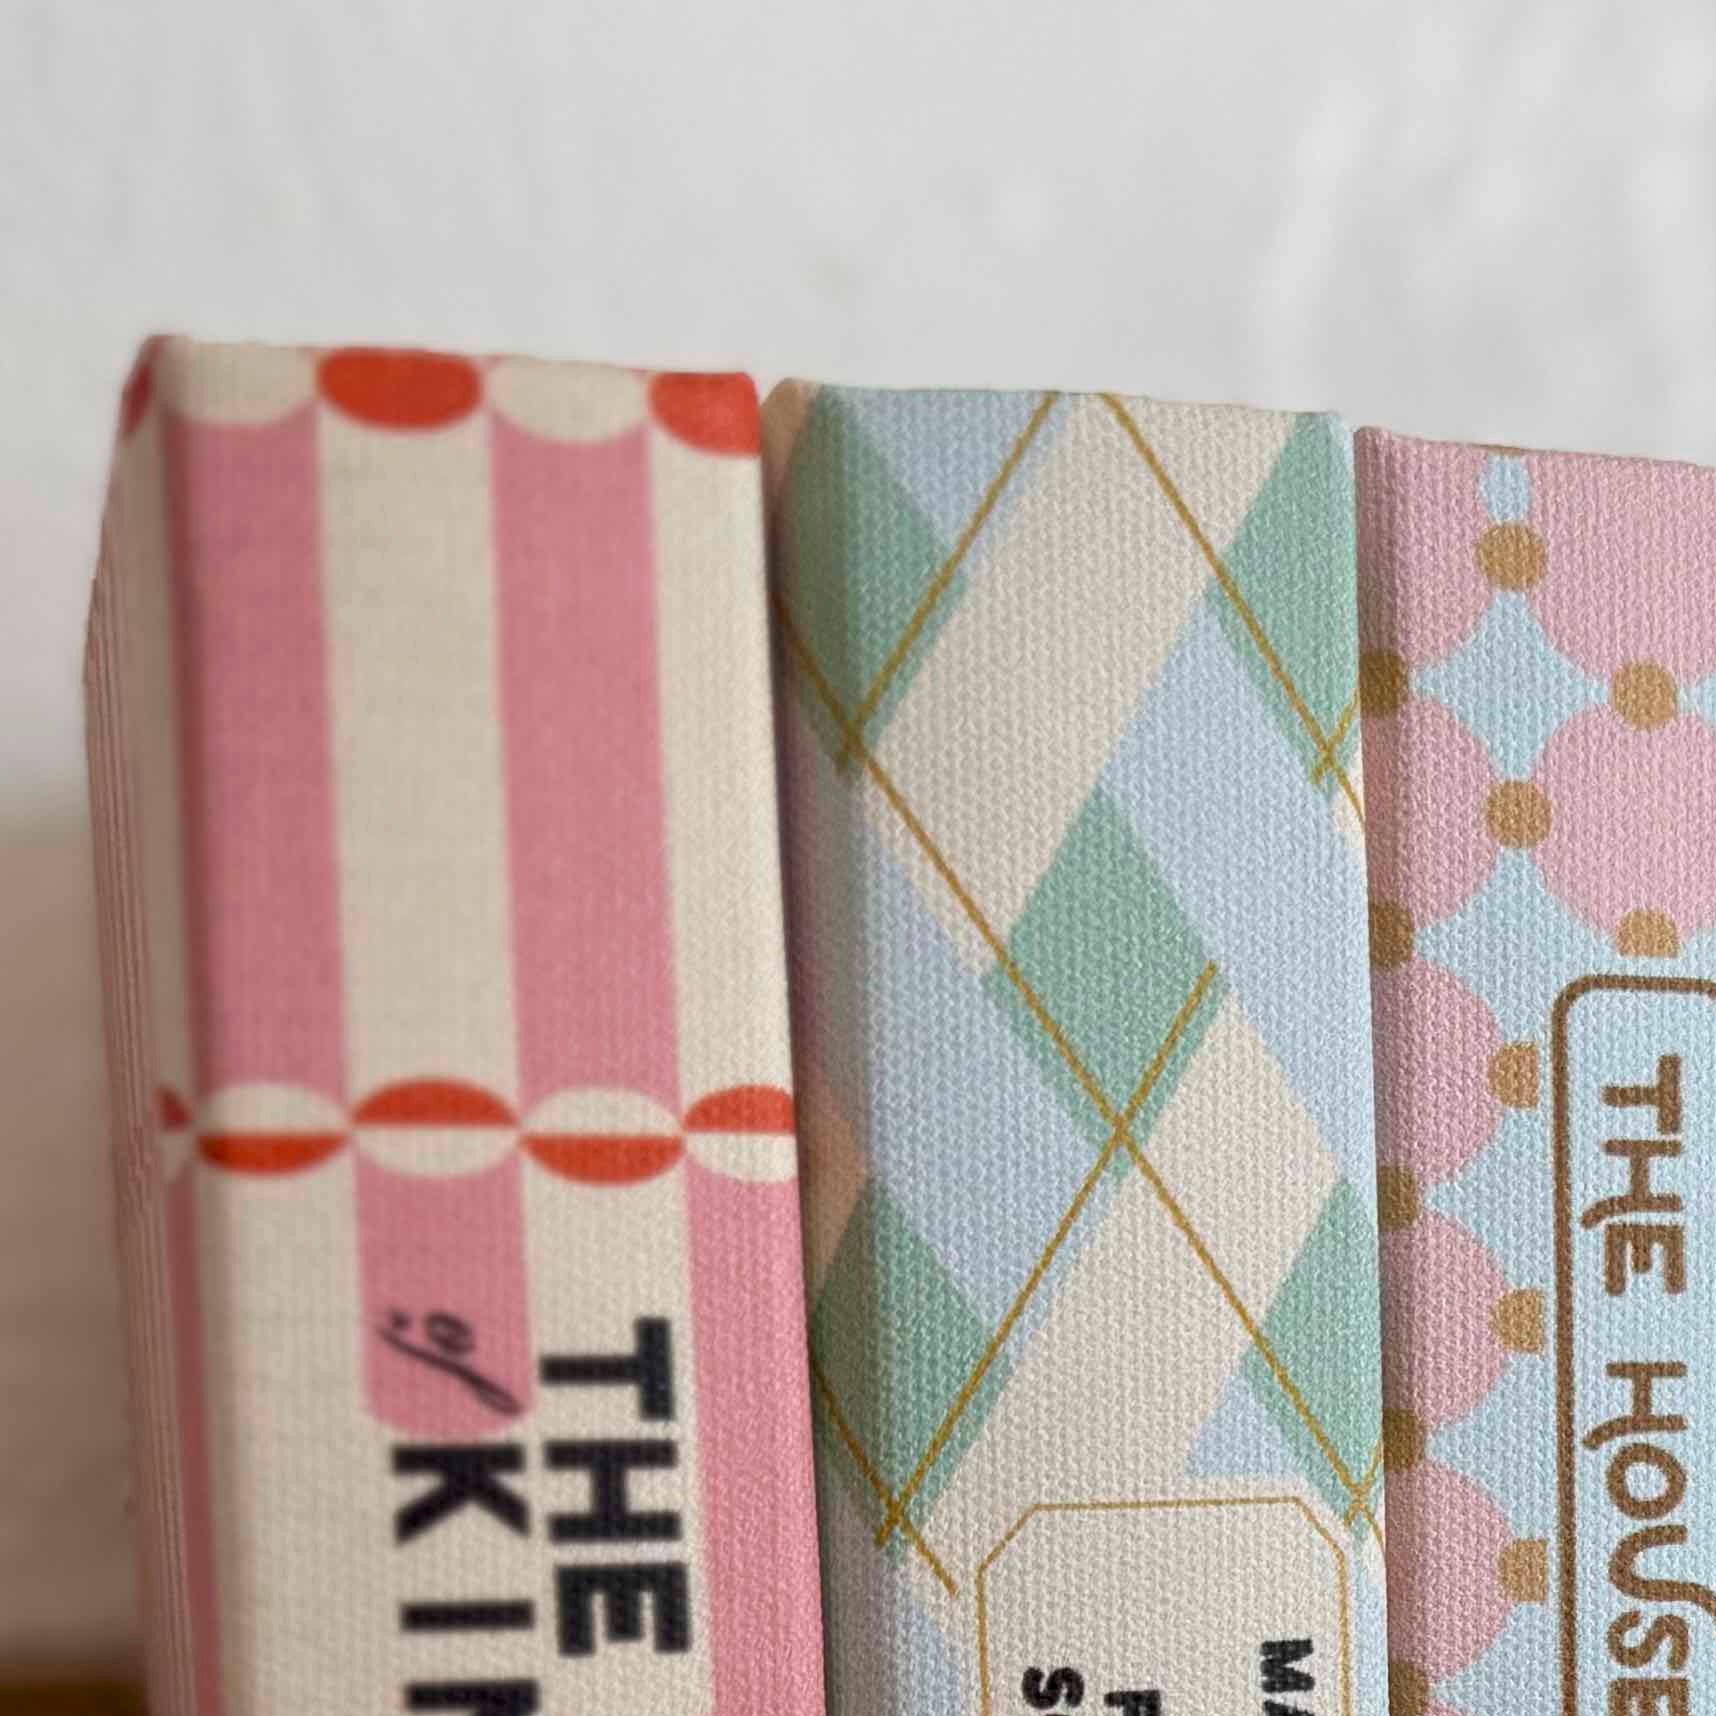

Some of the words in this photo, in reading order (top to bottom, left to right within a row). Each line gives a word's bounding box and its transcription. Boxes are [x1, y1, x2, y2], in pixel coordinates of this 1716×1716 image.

[1580, 1052, 1687, 1297] THE
[376, 1310, 522, 1418] of
[539, 1317, 691, 1657] THE
